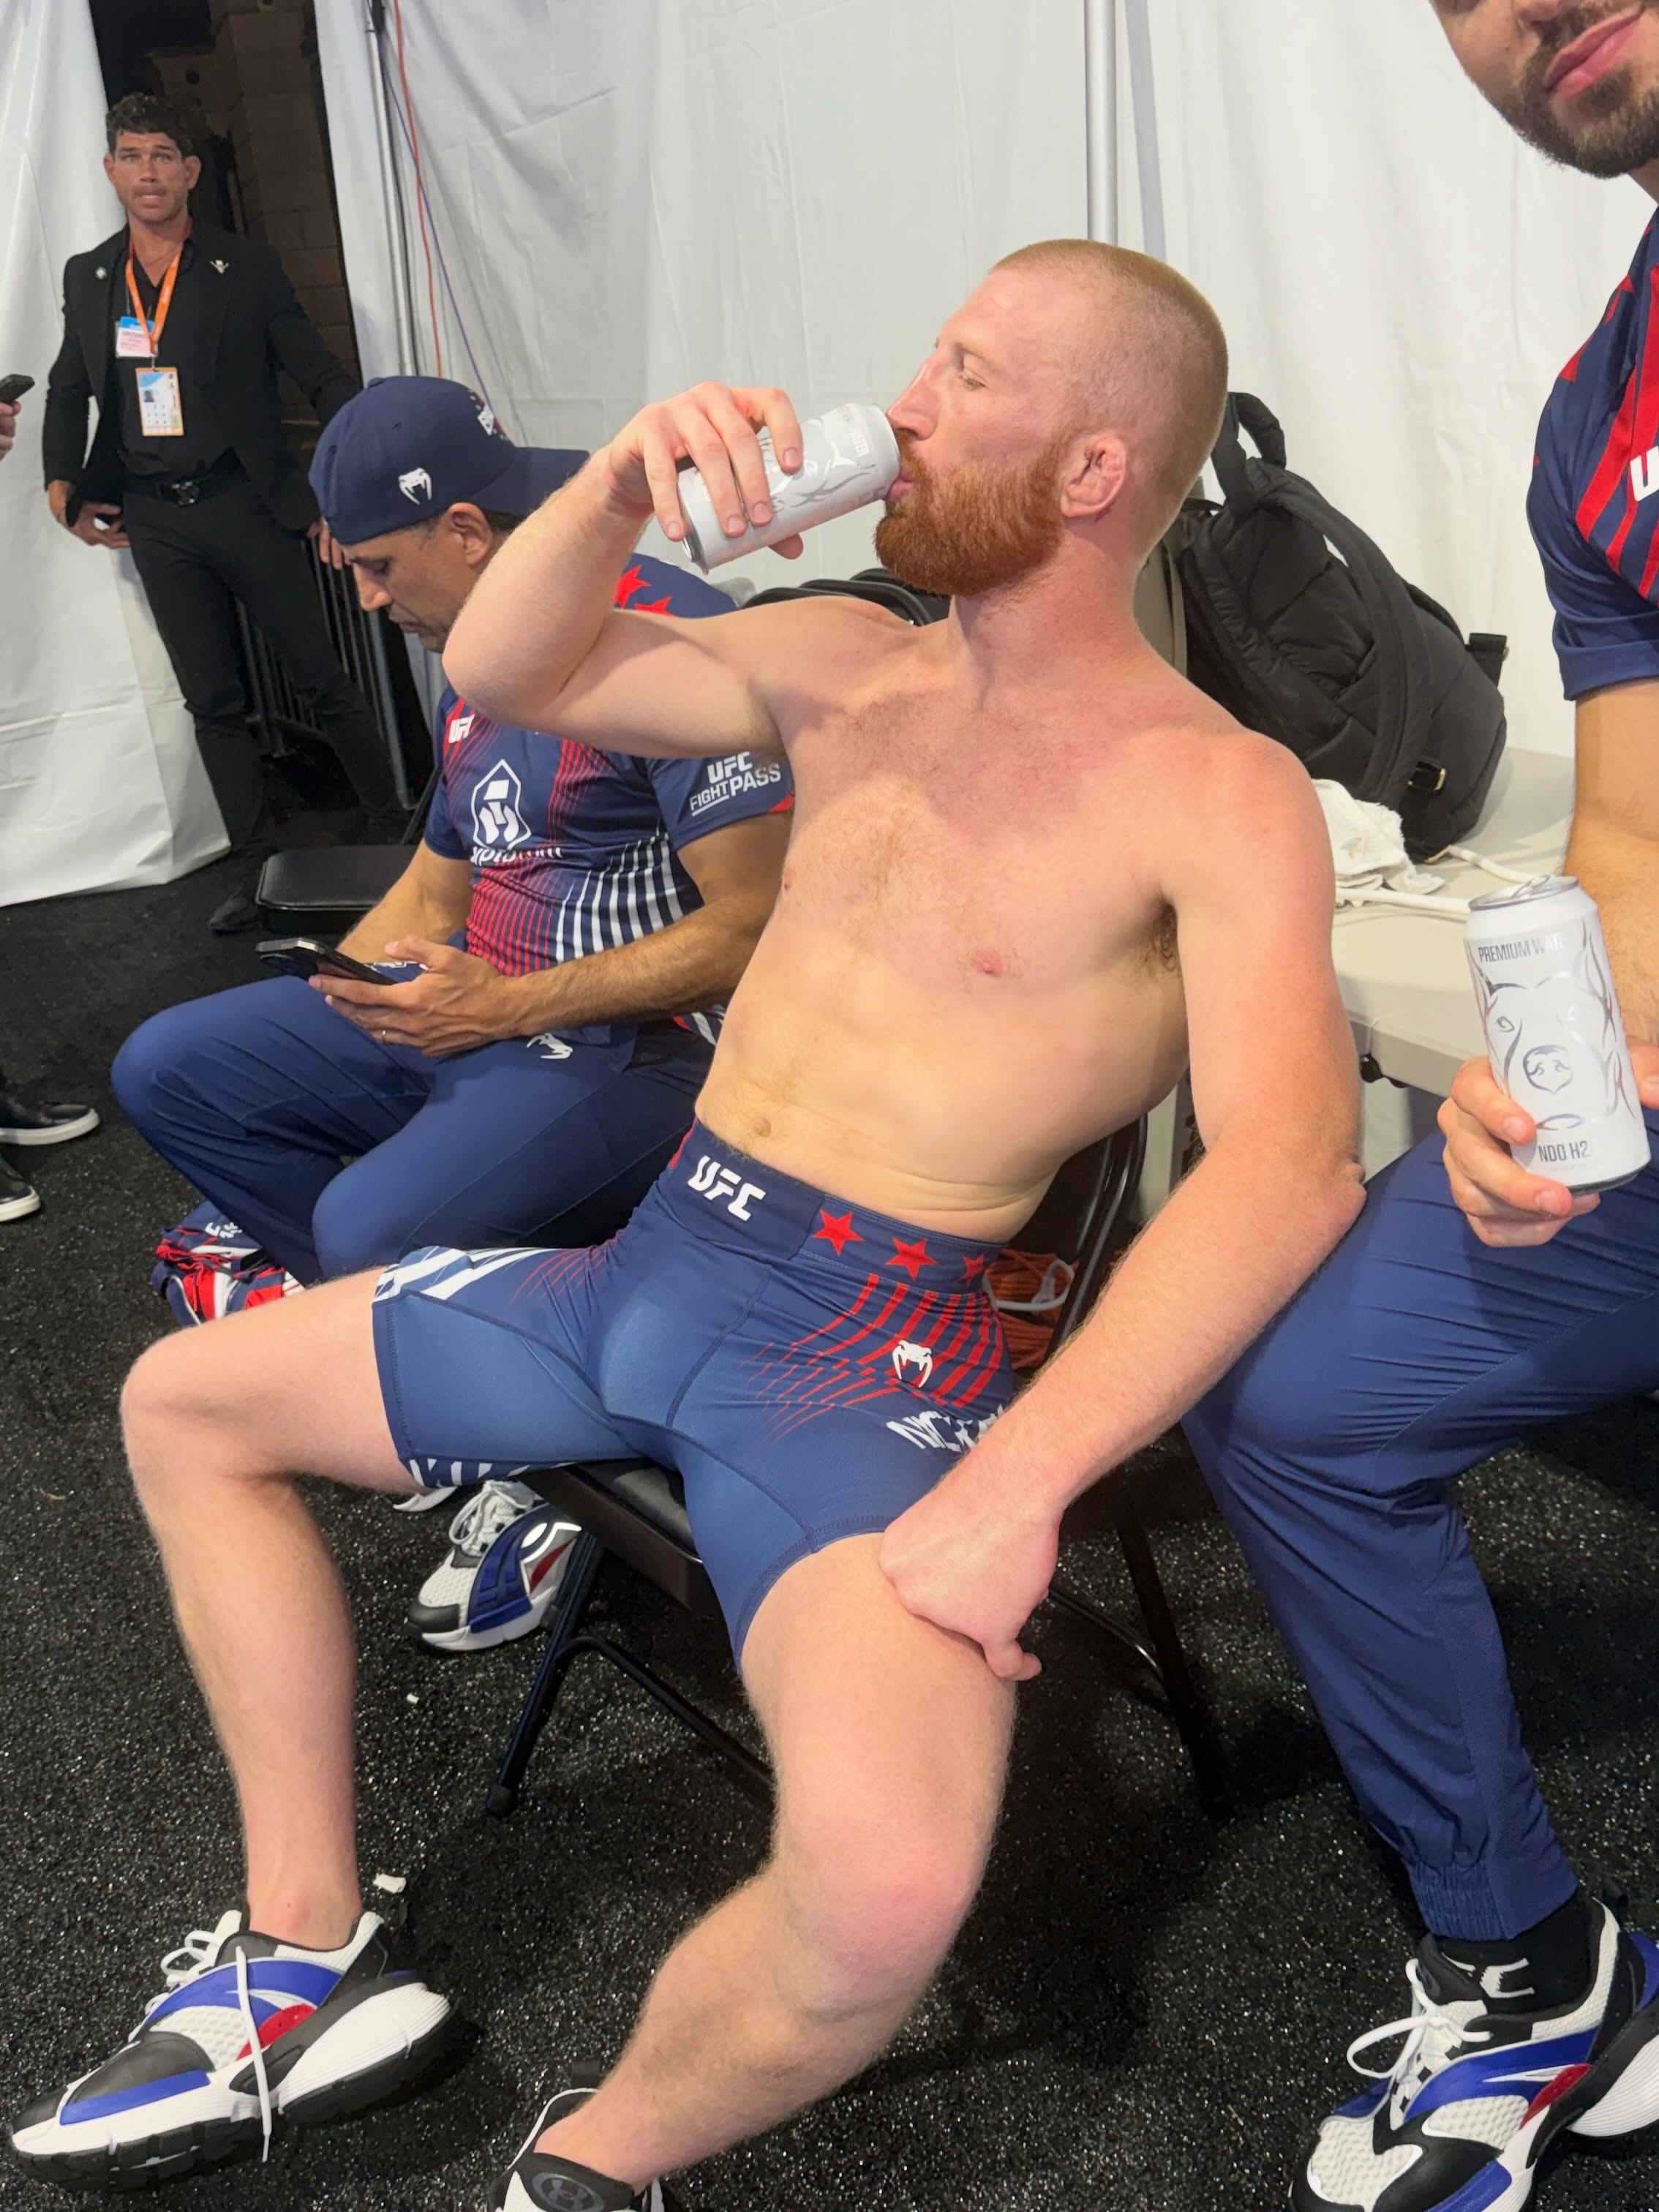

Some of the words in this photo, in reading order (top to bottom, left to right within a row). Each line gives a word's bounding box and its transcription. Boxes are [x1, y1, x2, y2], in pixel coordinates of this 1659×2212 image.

[689, 780, 729, 811] FIGHT
[730, 762, 781, 797] PASS
[707, 751, 753, 783] UFC
[1478, 940, 1531, 963] PREMIUM
[688, 1155, 767, 1222] UFC
